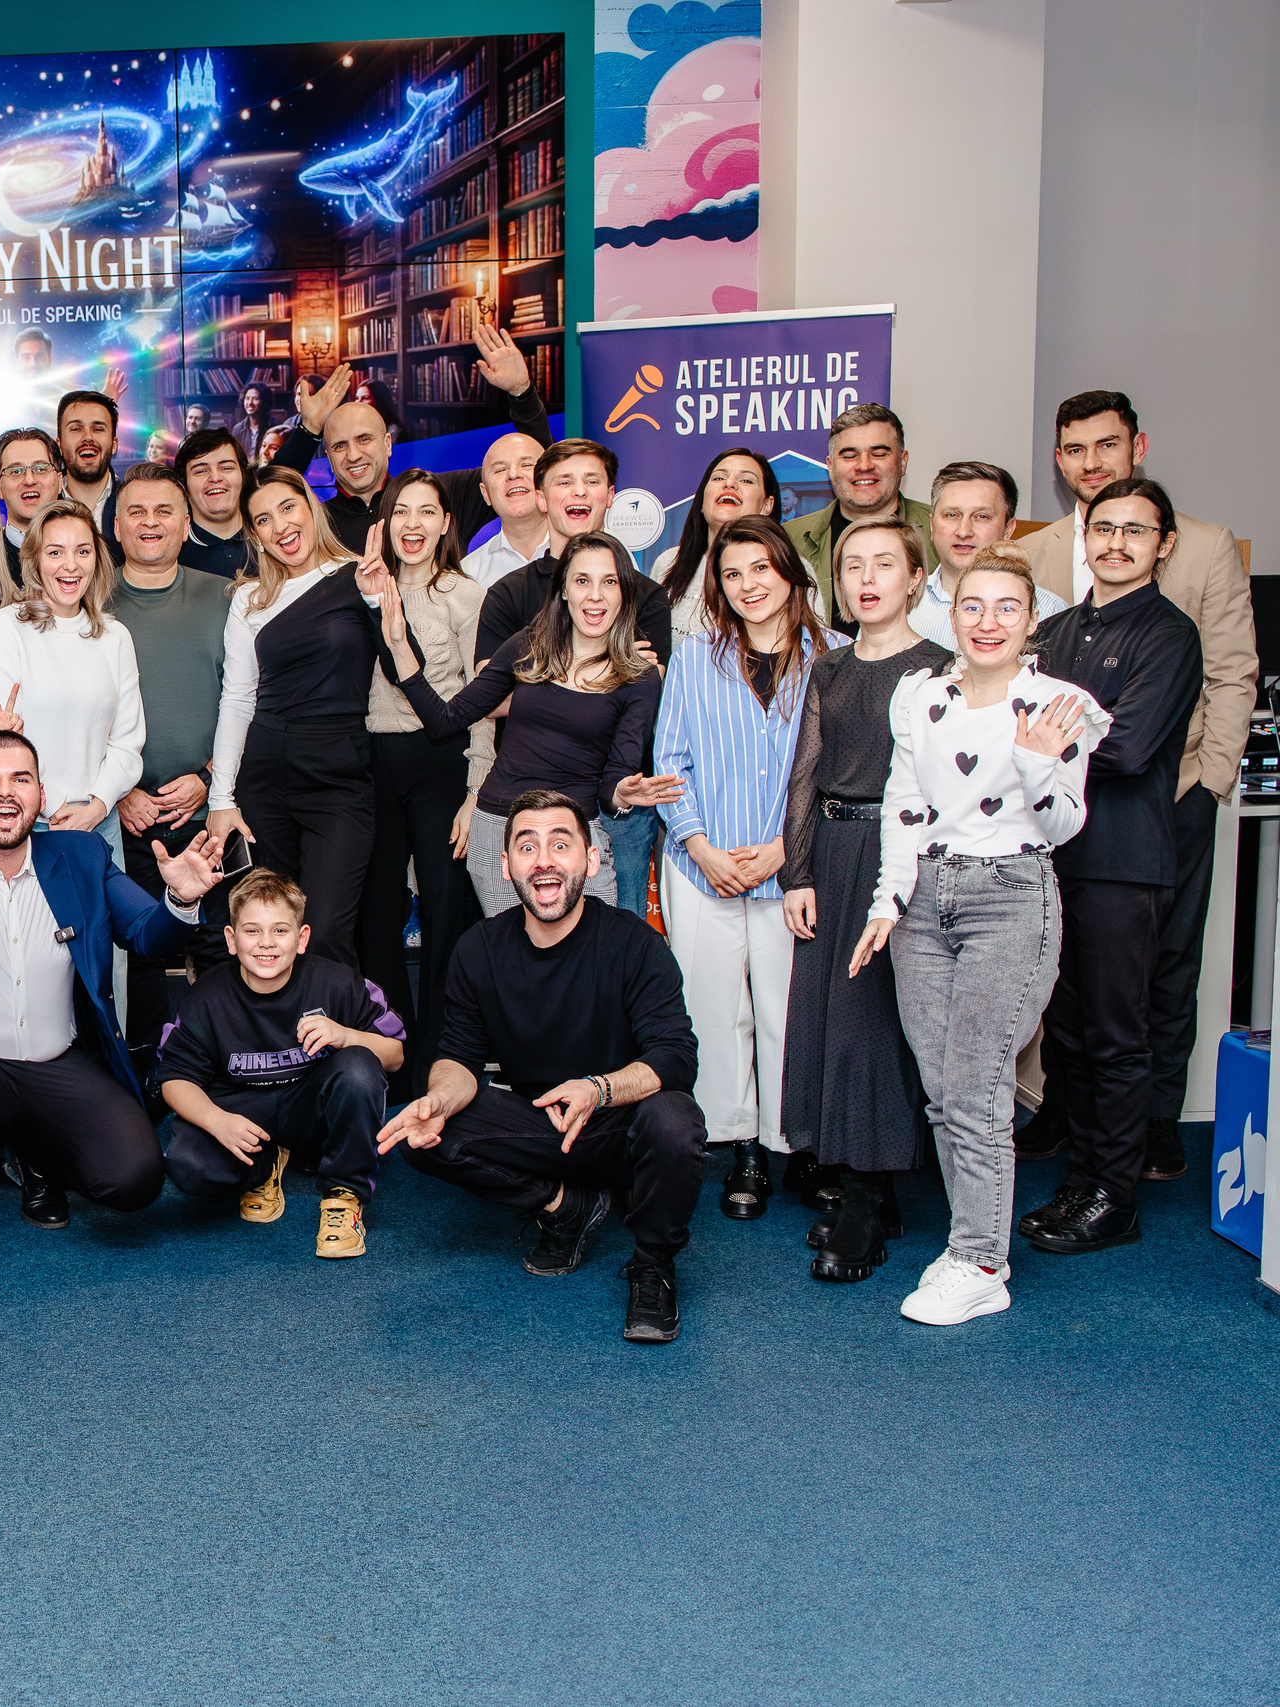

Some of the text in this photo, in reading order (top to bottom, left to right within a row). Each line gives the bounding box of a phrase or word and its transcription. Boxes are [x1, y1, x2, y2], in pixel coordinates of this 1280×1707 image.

[21, 307, 41, 324] DE
[45, 303, 122, 323] SPEAKING
[675, 351, 859, 390] ATELIERUL DE
[675, 386, 859, 435] SPEAKING
[229, 1046, 330, 1071] MINECR
